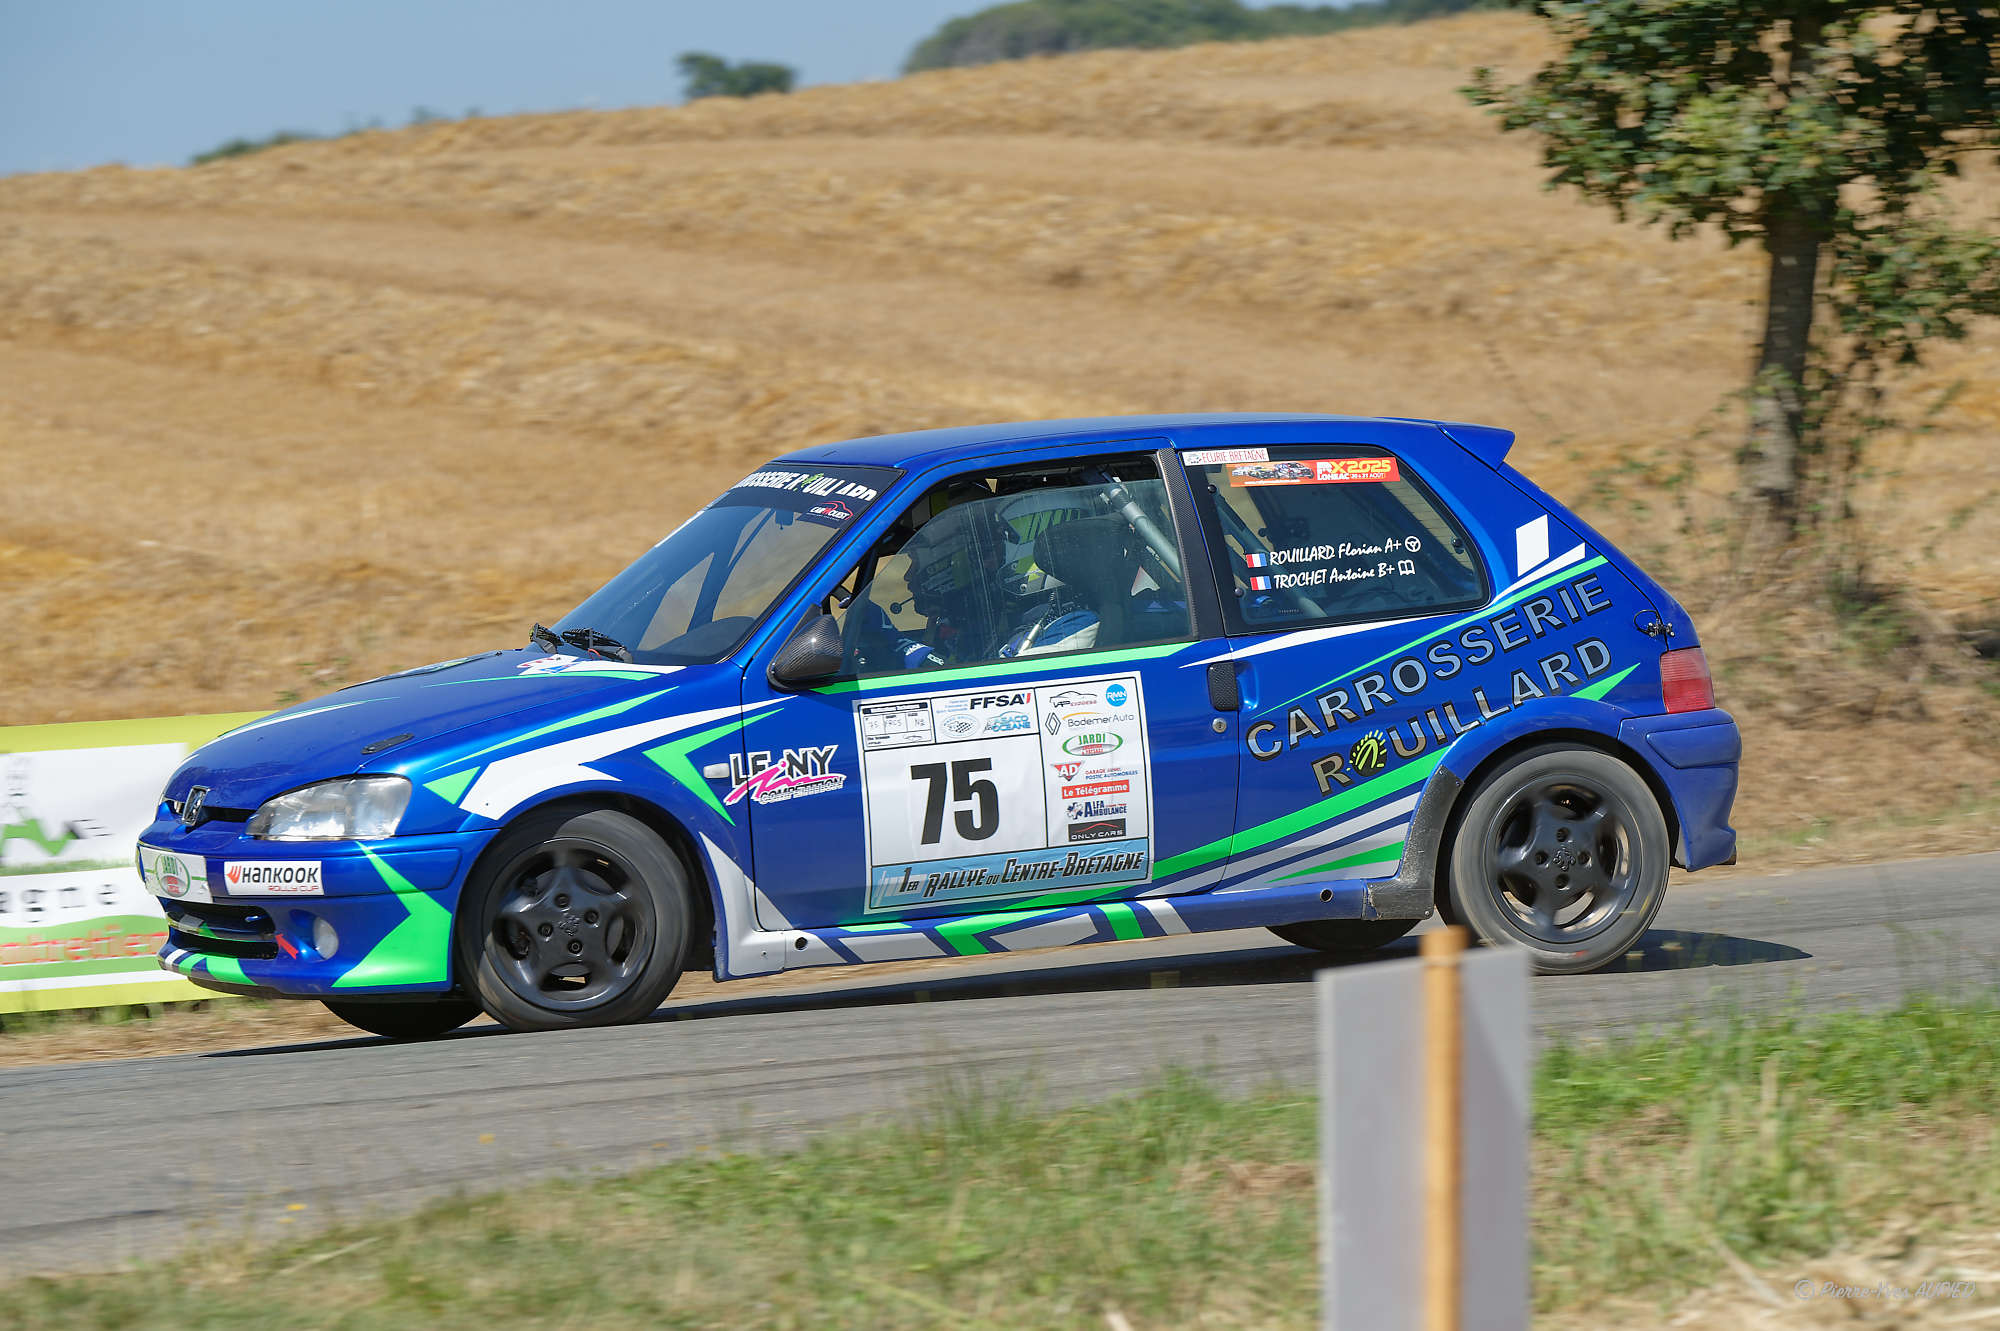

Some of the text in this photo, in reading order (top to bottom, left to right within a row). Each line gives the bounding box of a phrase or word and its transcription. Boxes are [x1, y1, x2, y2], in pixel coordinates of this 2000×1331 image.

[1229, 449, 1265, 462] BRETAGNE
[1270, 537, 1402, 566] ROUILLARD Florian A+
[1274, 562, 1396, 589] TROCHET Antoine B+
[1246, 573, 1613, 761] CARROSSERIE
[969, 693, 1025, 710] FFSA
[1078, 733, 1106, 745] JARDI
[1059, 763, 1078, 776] AD
[1063, 783, 1128, 797] Le Télégramme
[911, 757, 999, 845] 75
[1071, 829, 1123, 840] ONLY CARS
[923, 868, 988, 897] RALLYE
[1000, 851, 1145, 883] CENTRE-BRETAGNE
